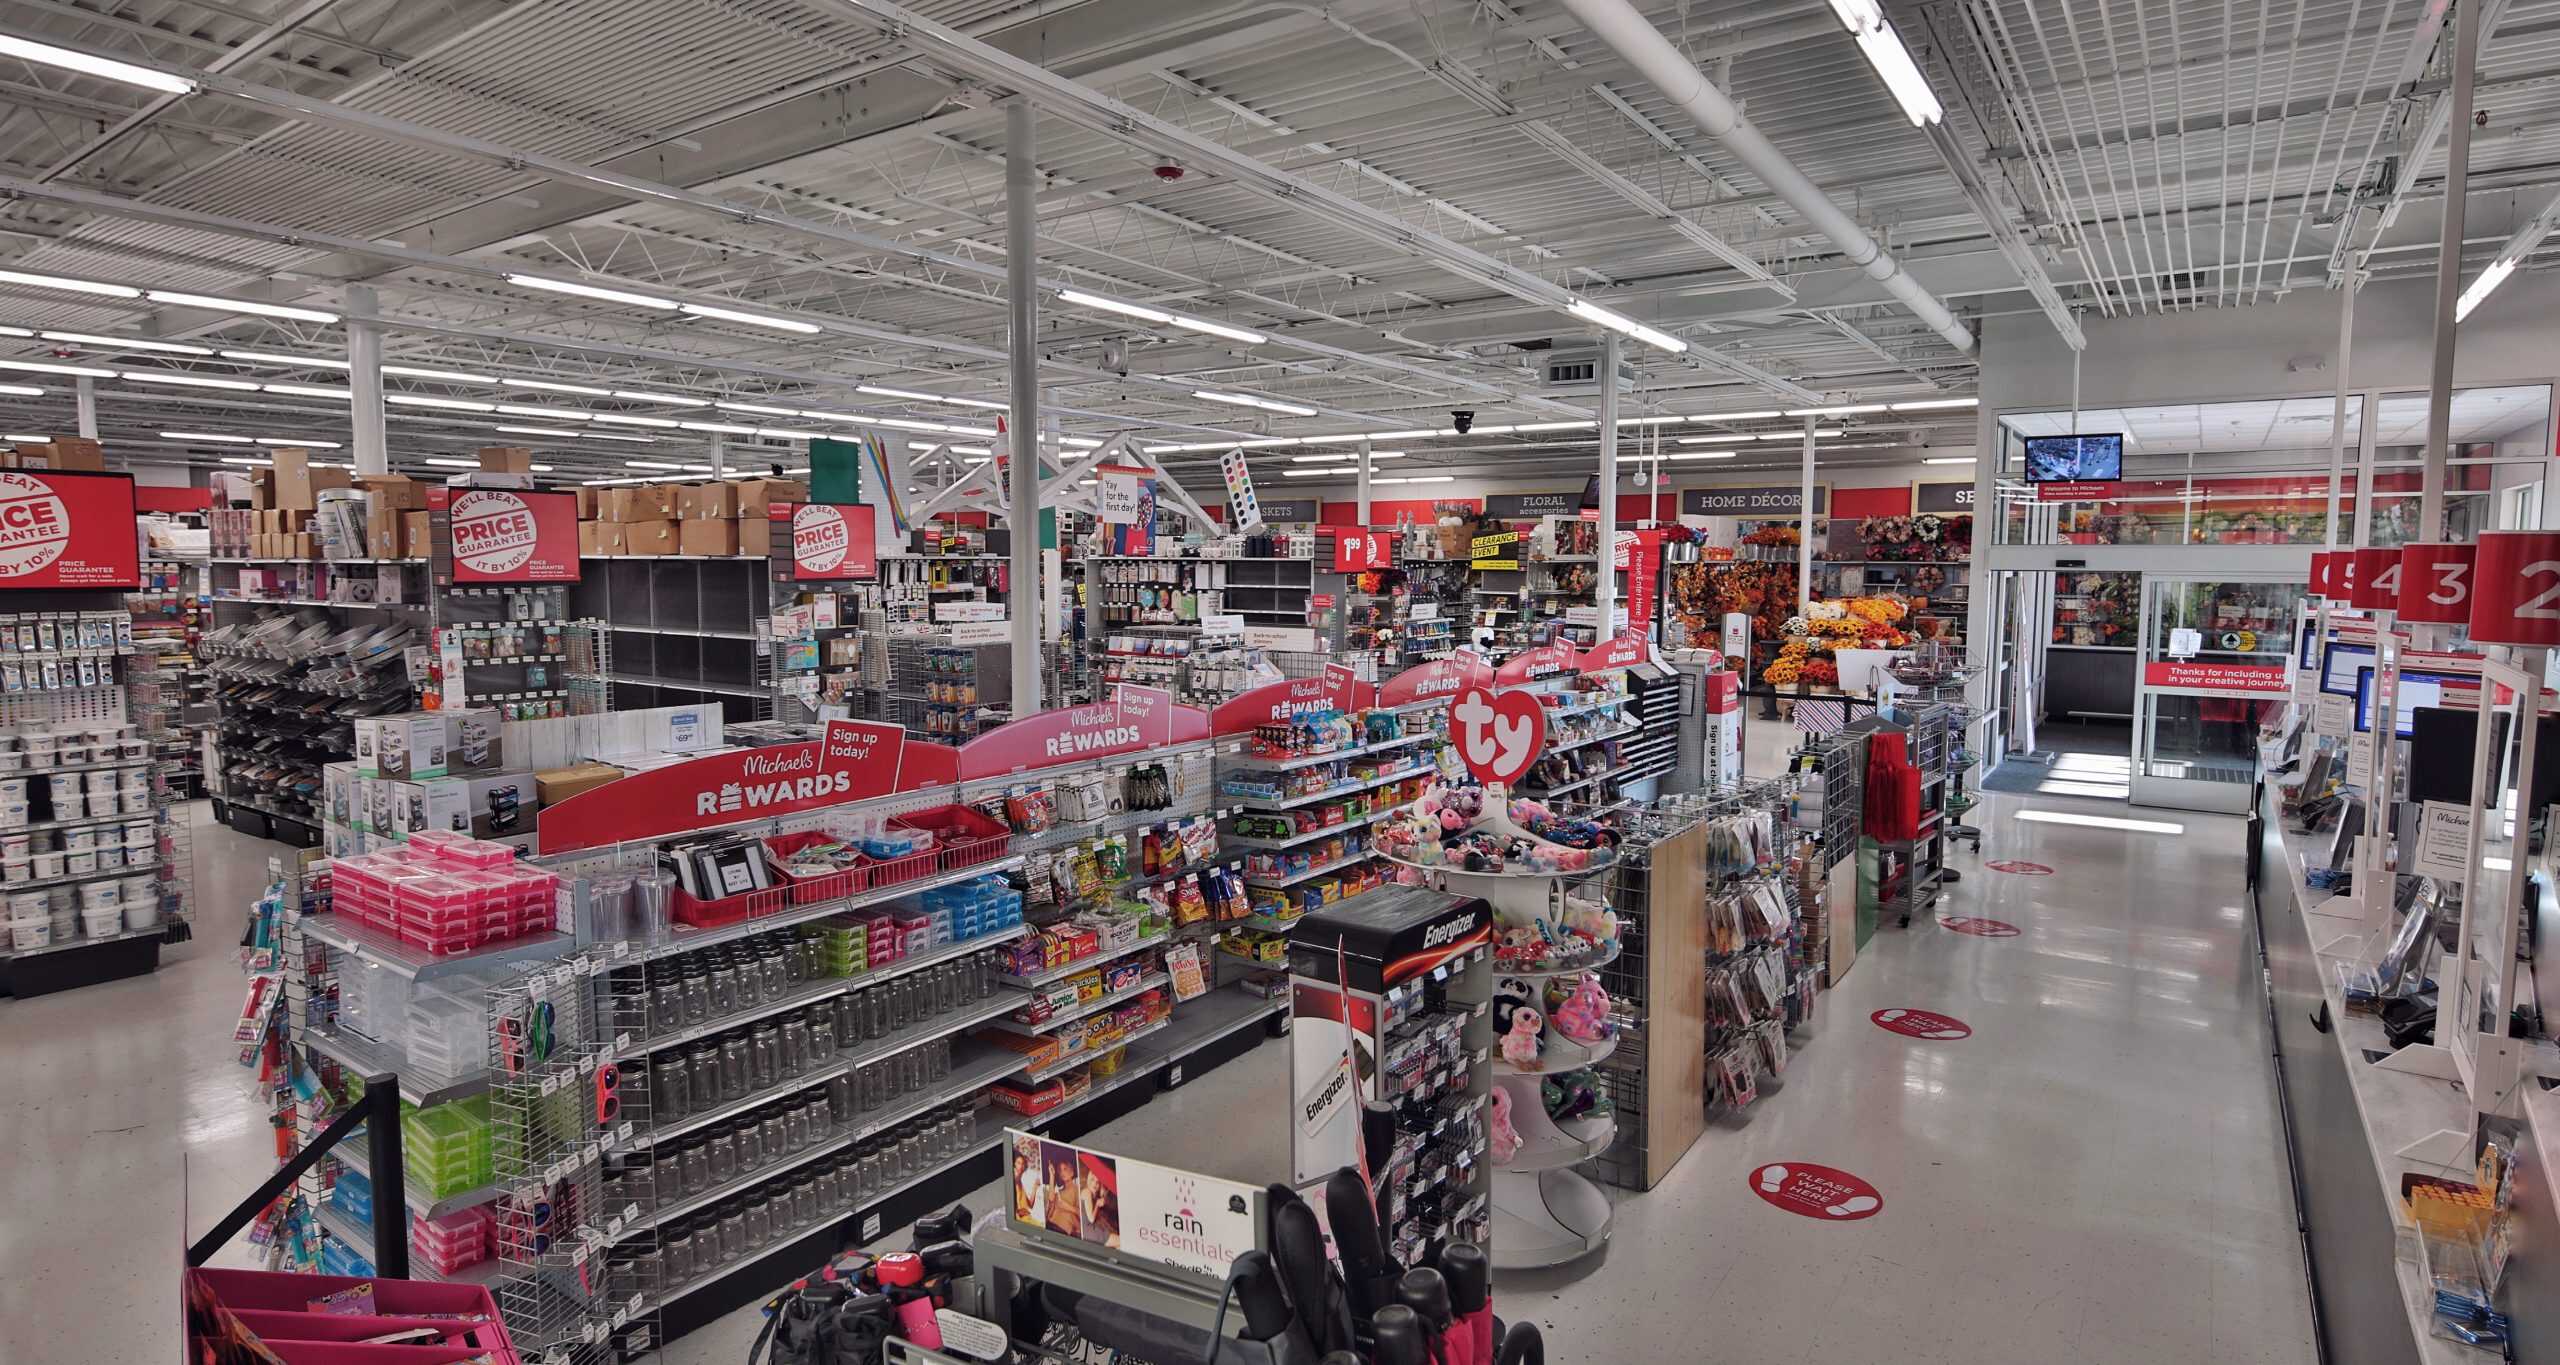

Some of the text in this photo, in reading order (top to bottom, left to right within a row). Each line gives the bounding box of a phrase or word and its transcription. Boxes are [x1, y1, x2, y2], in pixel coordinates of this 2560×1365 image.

[0, 474, 41, 492] EAT
[1106, 480, 1117, 491] Yay
[452, 491, 519, 518] WE'LL BEAT
[1106, 491, 1129, 501] for the
[1523, 496, 1565, 506] FLORAL
[1701, 492, 1803, 508] HOME DÉCOR
[0, 501, 57, 531] CE
[1106, 502, 1136, 514] first day!
[1262, 507, 1293, 516] SKETS
[1519, 507, 1569, 515] accessories
[453, 514, 529, 545] PRICE
[795, 523, 843, 549] PRICE
[458, 532, 531, 554] GUARANTEE
[797, 540, 845, 556] GUARANTEE
[1473, 532, 1517, 547] CLEARANCE
[1615, 540, 1637, 553] RIC
[25, 547, 55, 570] 10%
[1473, 547, 1498, 558] EVENT
[476, 561, 488, 569] IT
[491, 563, 506, 571] BY
[1636, 552, 1644, 576] Please
[2371, 563, 2400, 596] 4
[2427, 563, 2469, 605] 3
[2514, 560, 2560, 619] 2
[1608, 651, 1637, 664] REWARDS
[1525, 662, 1560, 678] REWARDS
[2170, 667, 2206, 676] Thanks
[2207, 668, 2222, 676] for
[2224, 670, 2272, 679] including
[1416, 677, 1460, 696] REWARDS
[2180, 677, 2202, 685] your
[2205, 677, 2245, 686] creative
[1124, 692, 1154, 705] Sign up
[1071, 707, 1114, 727] Michaels
[1123, 704, 1150, 718] today!
[1271, 697, 1334, 720] REWARDS
[832, 728, 878, 745] Sign up
[1046, 725, 1141, 756] REWARDS
[1454, 690, 1533, 777] ty
[1710, 725, 1718, 744] Sign
[830, 744, 869, 759] today!
[1710, 746, 1717, 757] up
[743, 749, 813, 776] Michaels
[697, 770, 851, 816] REWARDS
[2437, 813, 2470, 826] Michae
[1423, 911, 1475, 949] Energizer
[1305, 1072, 1346, 1121] Energizer
[1796, 1172, 1856, 1194] PLEASE
[1798, 1180, 1841, 1197] WAIT
[1789, 1186, 1831, 1203] HERE
[1164, 1208, 1203, 1237] rain
[1139, 1225, 1235, 1264] essentials
